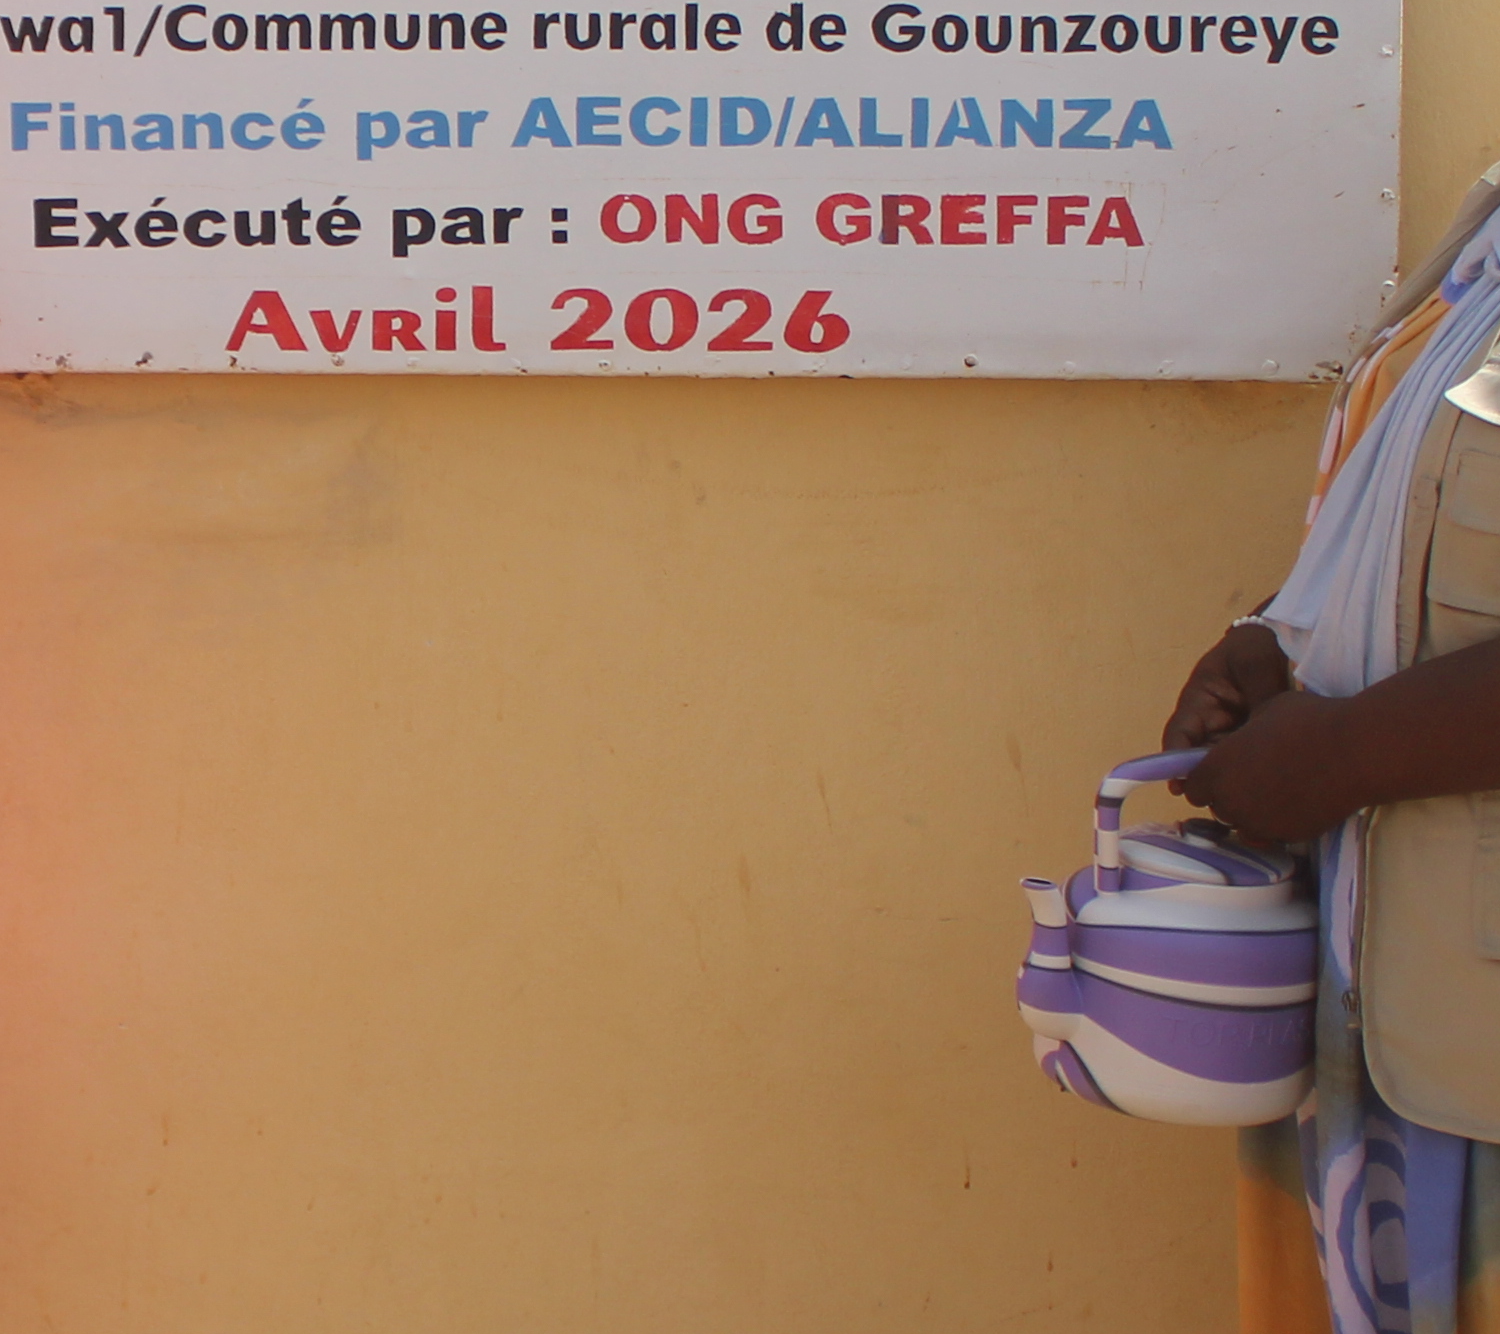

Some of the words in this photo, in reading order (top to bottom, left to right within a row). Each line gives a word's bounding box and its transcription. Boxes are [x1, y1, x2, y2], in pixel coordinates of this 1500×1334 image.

[533, 2, 742, 52] rurale
[765, 2, 847, 53] de
[871, 3, 1340, 65] Gounzoureye
[10, 97, 326, 152] Financé
[356, 109, 490, 161] par
[511, 96, 1174, 151] AECID/ALIANZA
[33, 195, 362, 249] Exécuté
[392, 206, 525, 258] par
[599, 192, 784, 246] ONG
[815, 192, 1145, 248] GREFFA
[550, 287, 851, 354] 2026
